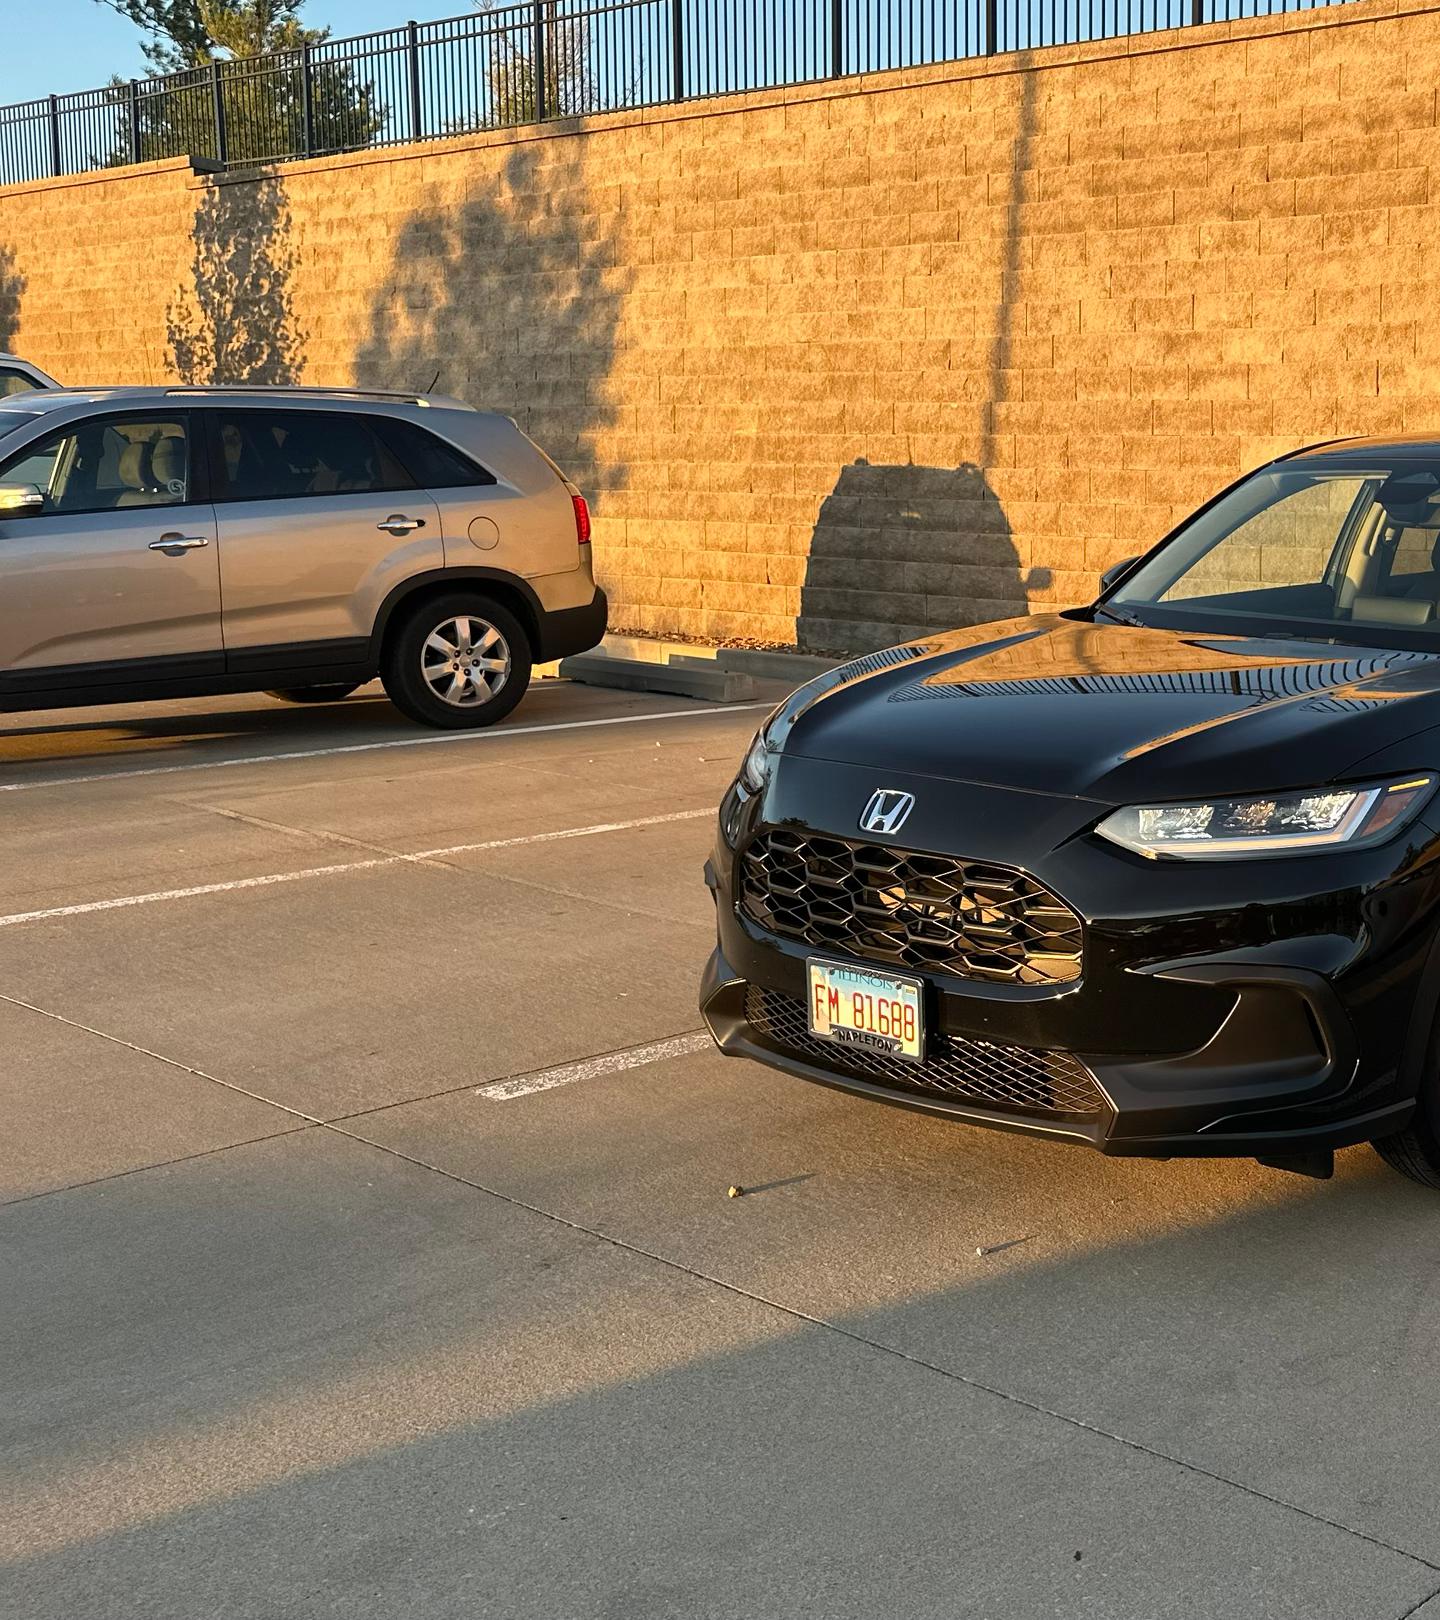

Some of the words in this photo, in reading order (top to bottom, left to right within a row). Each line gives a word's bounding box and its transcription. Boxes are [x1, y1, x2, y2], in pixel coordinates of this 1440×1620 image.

[838, 970, 893, 990] ILLINOIS
[814, 984, 840, 1024] FM
[852, 992, 915, 1042] 81688
[838, 1031, 893, 1054] NAPLETON
